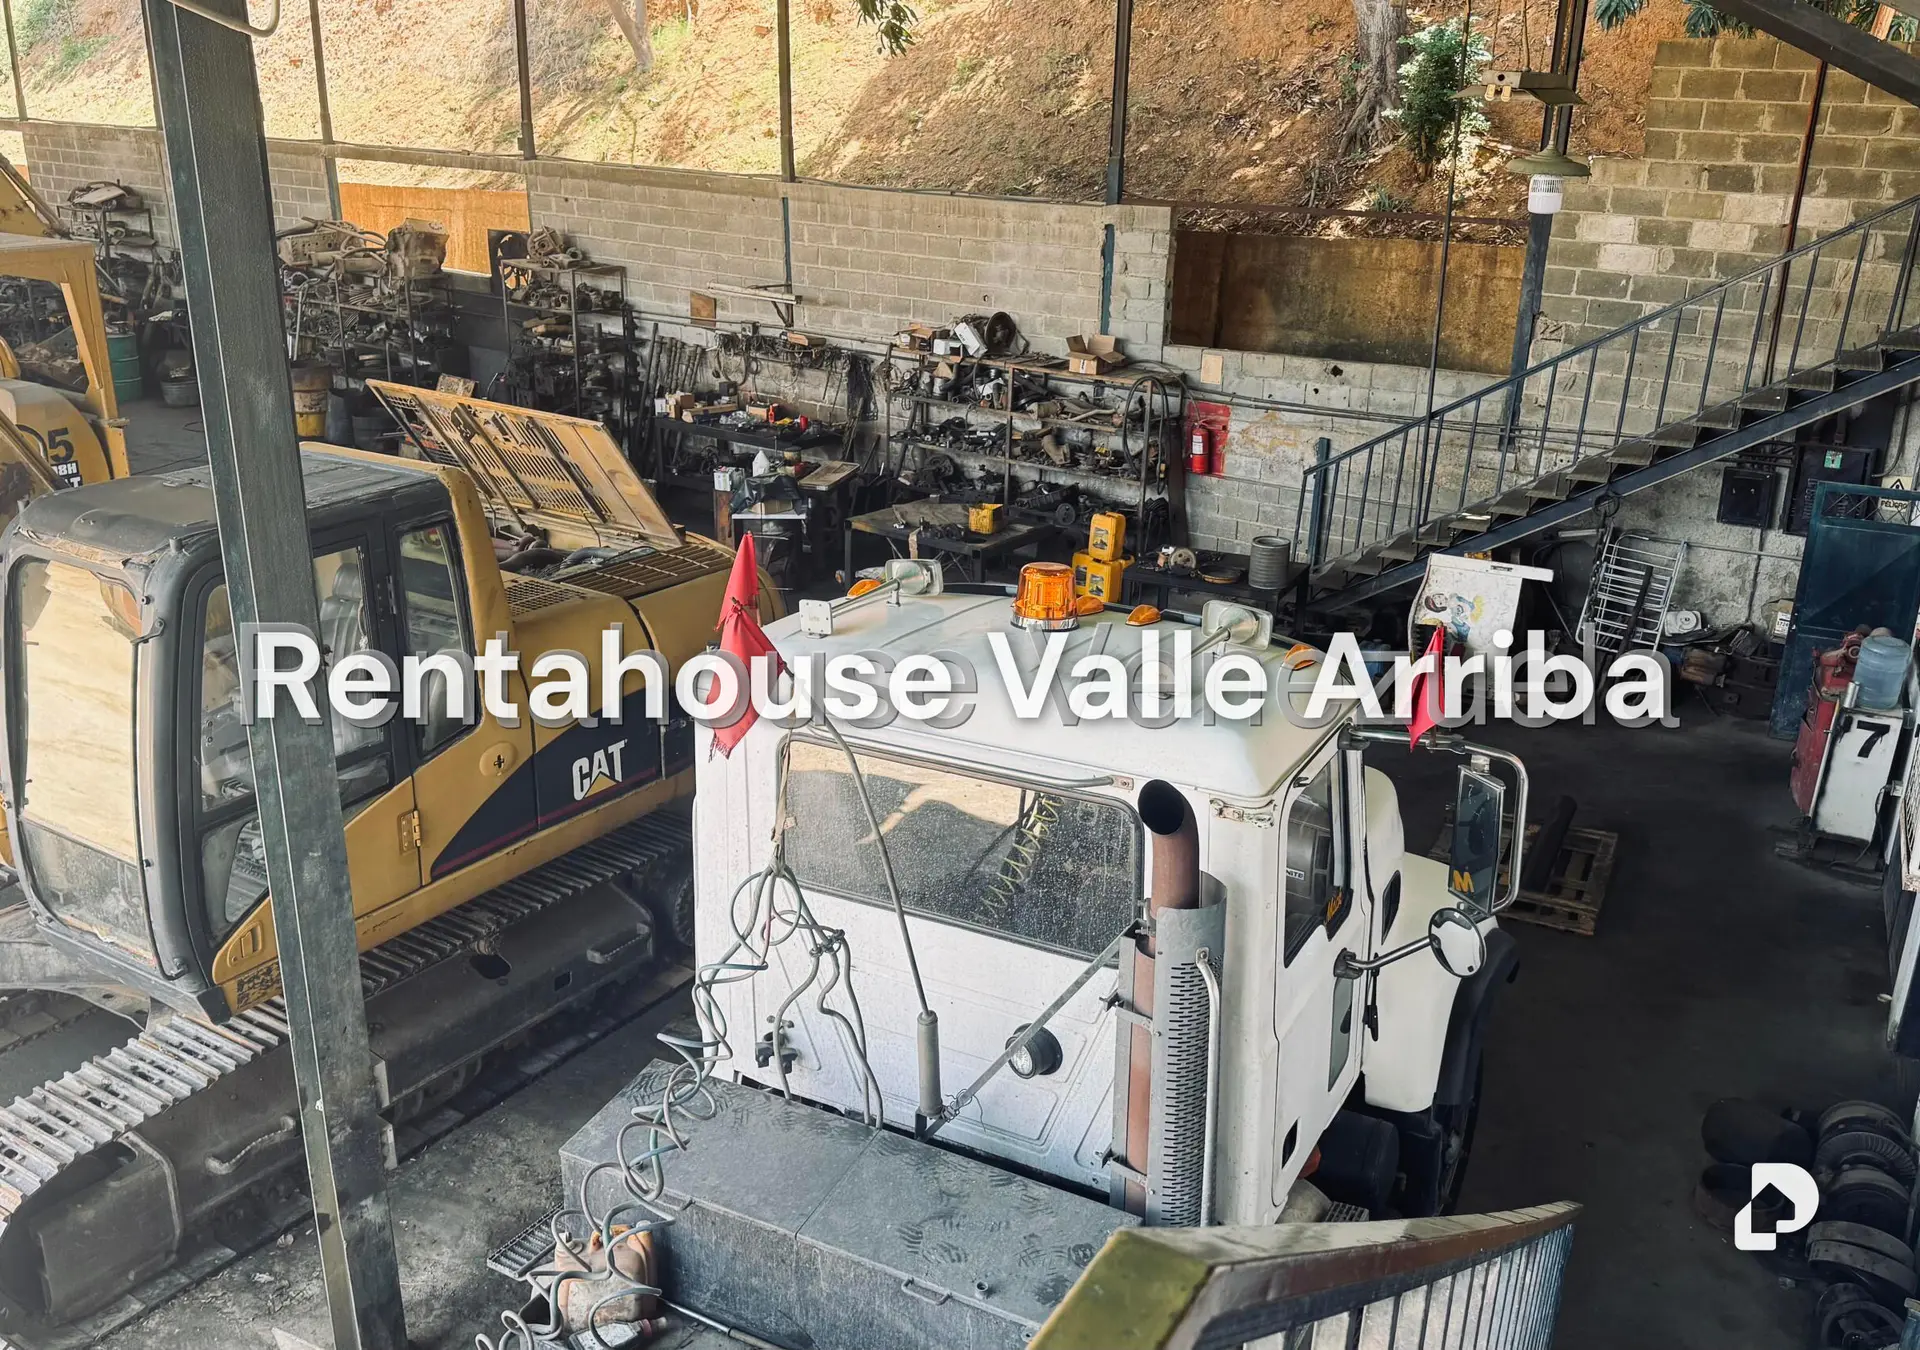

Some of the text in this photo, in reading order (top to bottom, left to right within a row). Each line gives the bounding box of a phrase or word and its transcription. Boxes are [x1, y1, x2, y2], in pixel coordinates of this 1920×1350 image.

[48, 427, 74, 463] 5
[1856, 719, 1891, 758] 7
[572, 739, 626, 801] CAT
